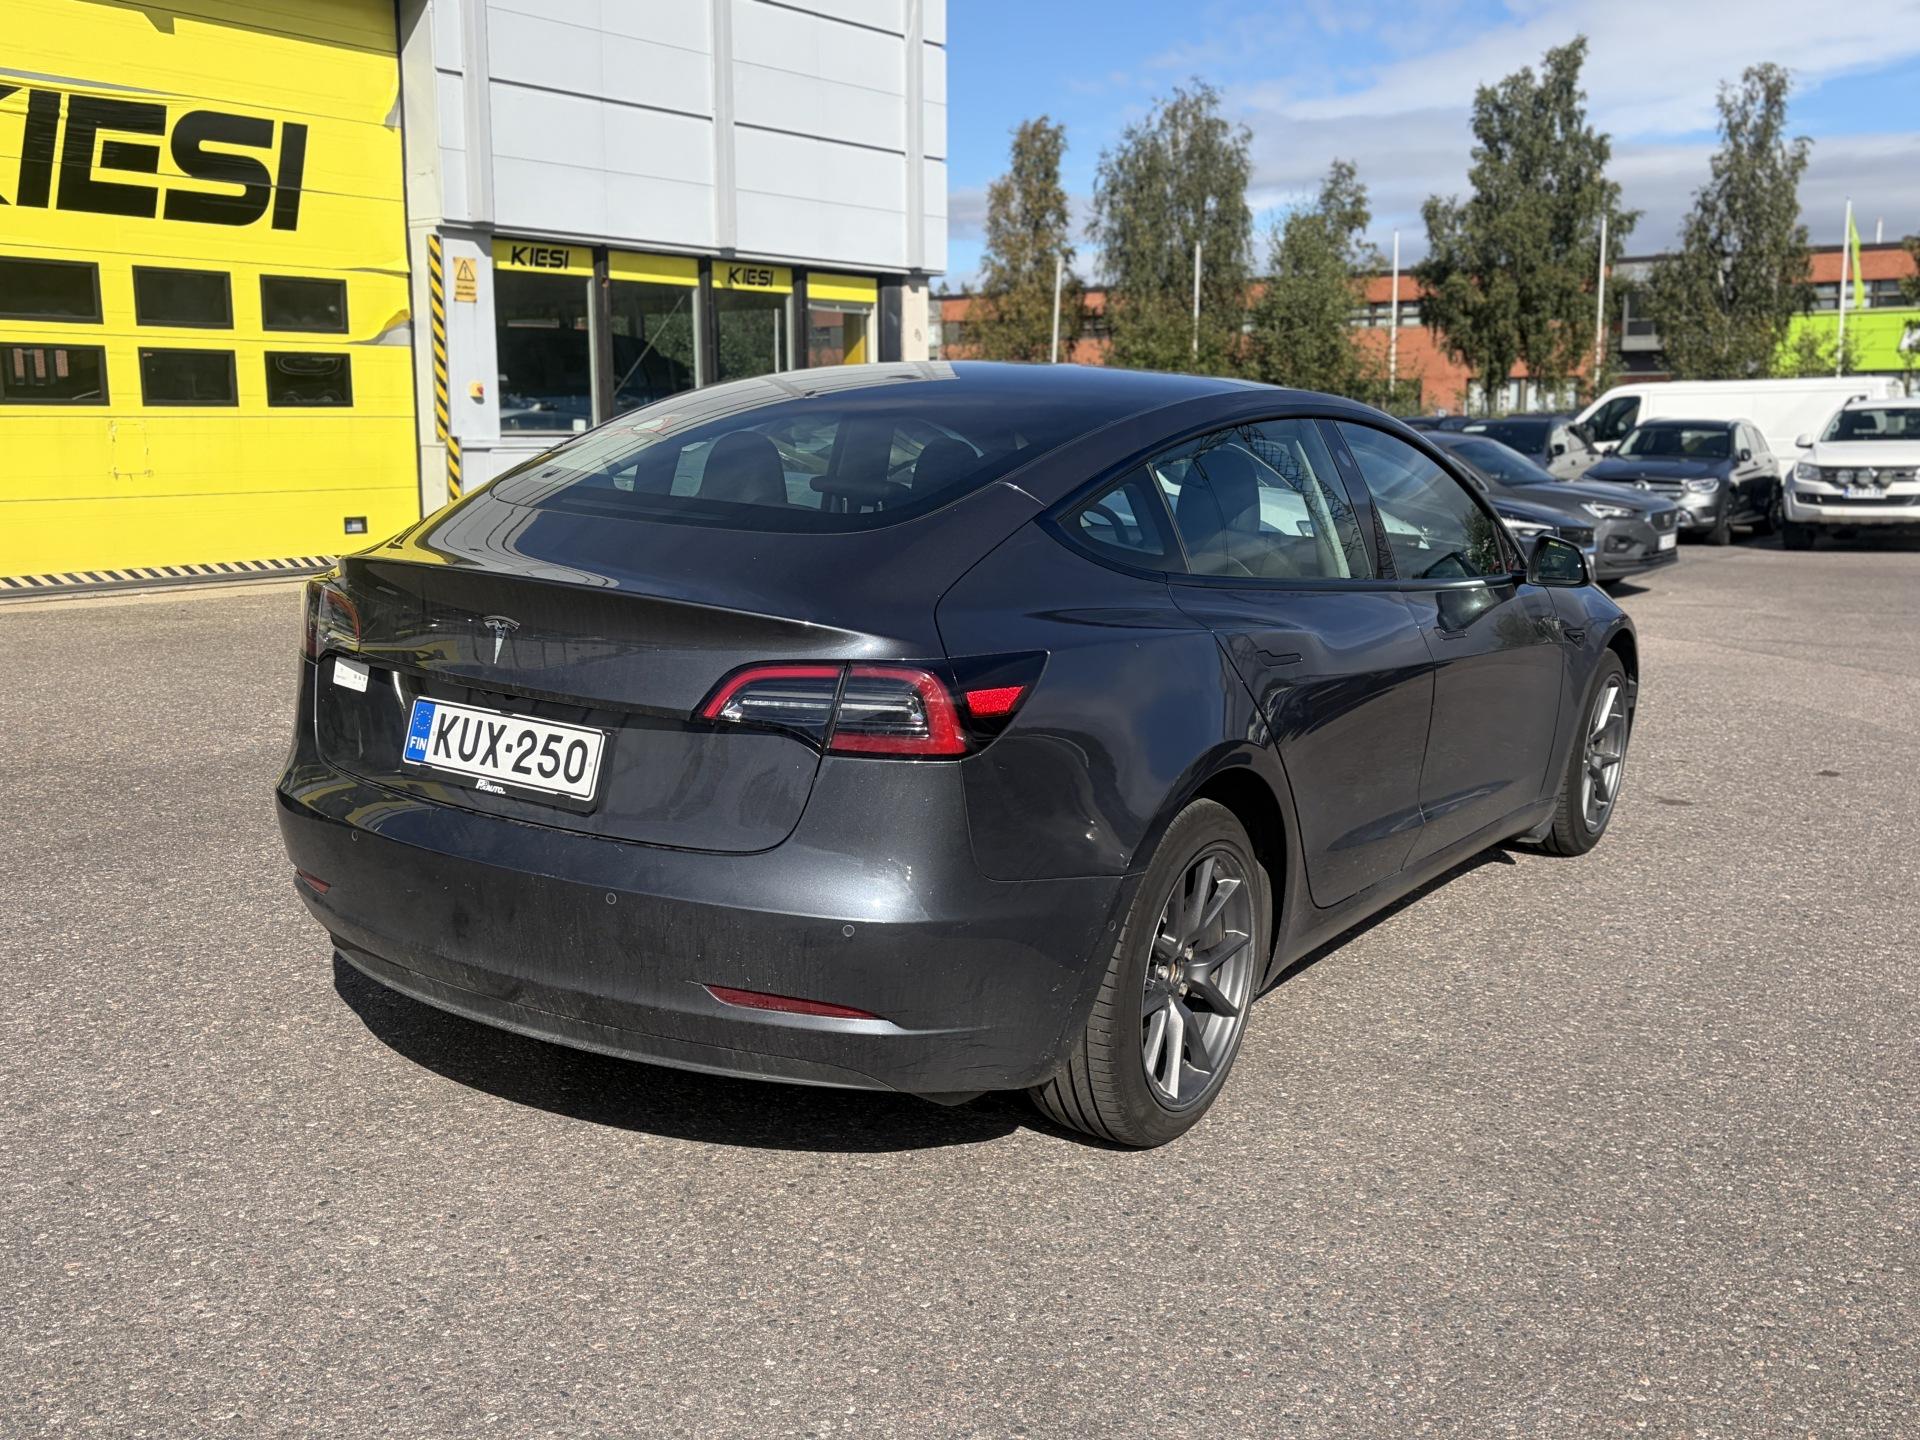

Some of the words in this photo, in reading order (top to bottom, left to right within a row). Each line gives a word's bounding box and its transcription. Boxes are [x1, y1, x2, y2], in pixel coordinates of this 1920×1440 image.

[0, 84, 308, 231] IESI
[511, 245, 570, 270] KIESI
[727, 266, 774, 288] KIESI
[409, 736, 427, 751] FIN
[433, 713, 588, 784] KUX-250
